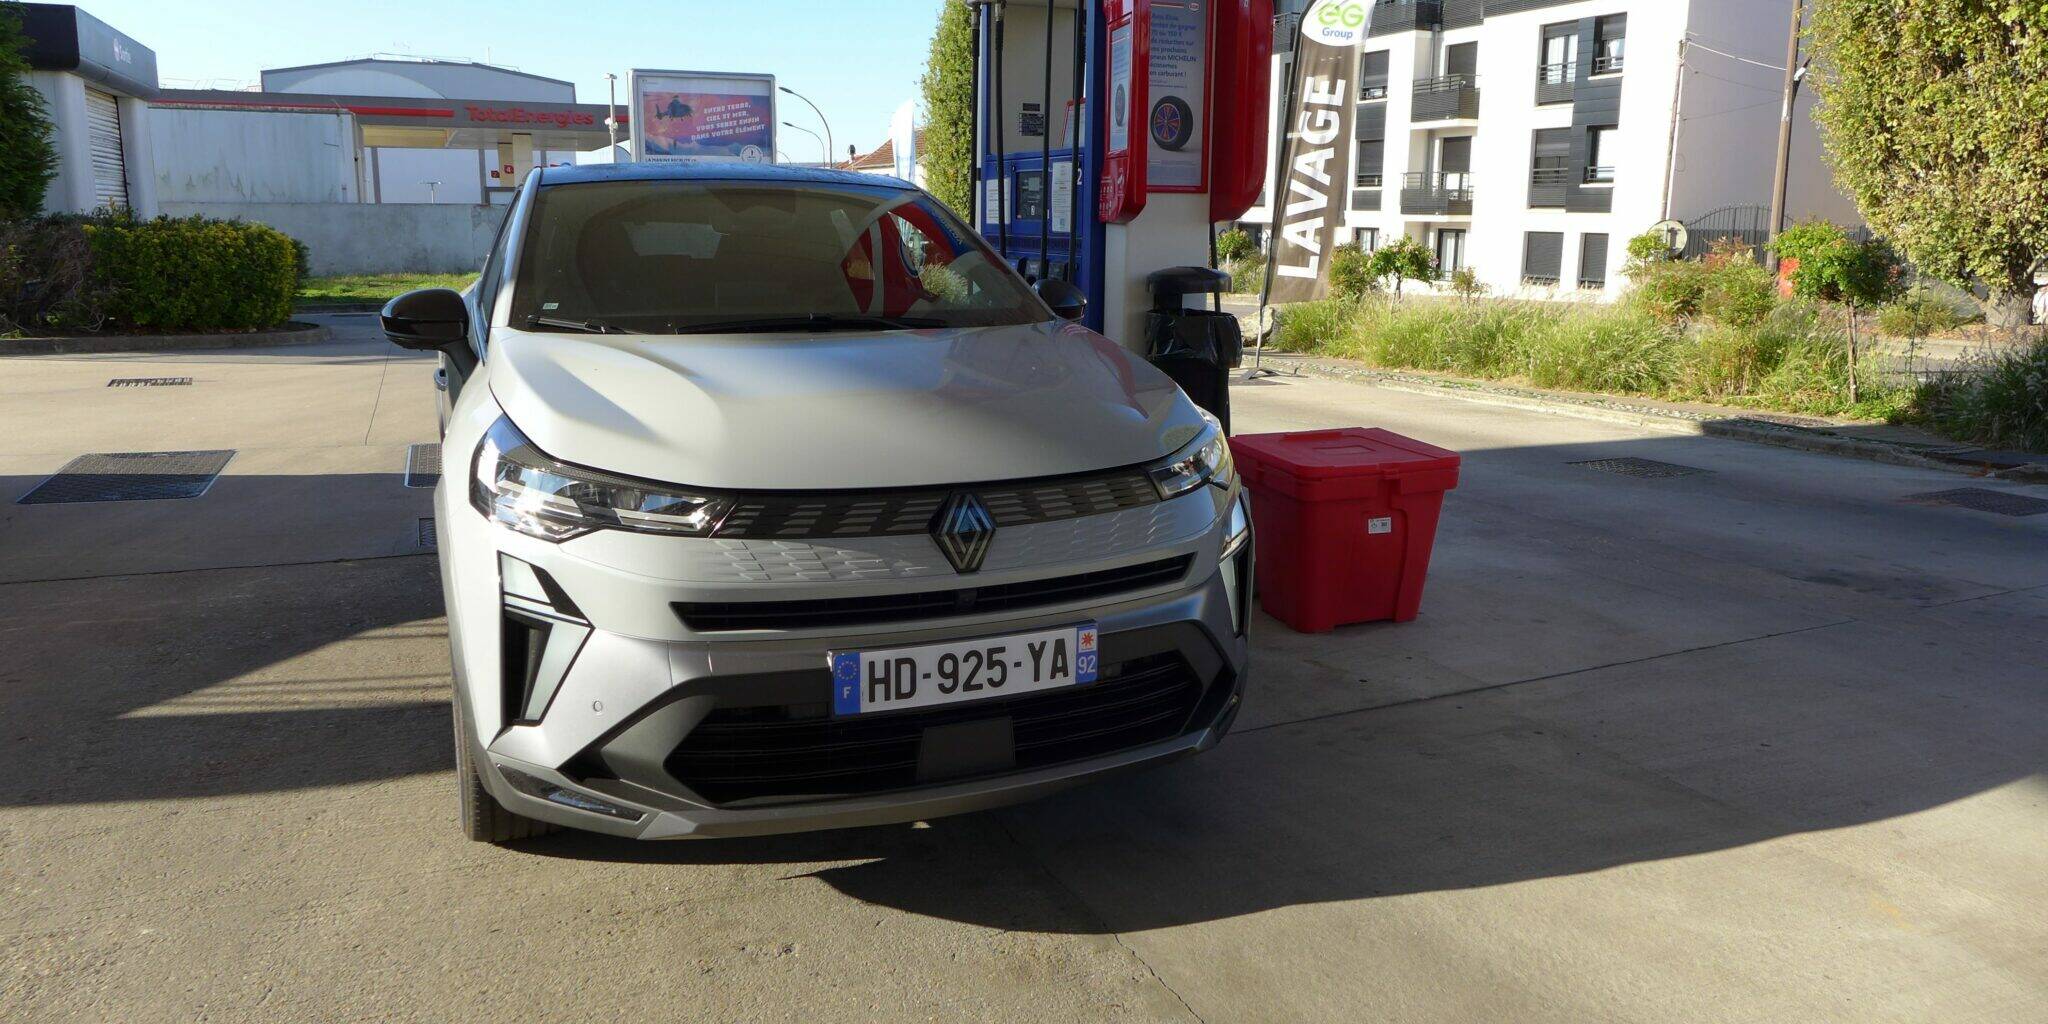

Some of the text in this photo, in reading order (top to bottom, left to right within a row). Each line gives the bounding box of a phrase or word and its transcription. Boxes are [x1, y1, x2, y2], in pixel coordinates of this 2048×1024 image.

[1322, 26, 1354, 40] Group
[464, 103, 594, 129] TotalEnergies
[703, 102, 751, 114] ENTRE TERRE,
[696, 116, 760, 132] VOUS SEREZ ENFIN
[706, 114, 721, 122] CIEL
[691, 123, 765, 141] DANS VOTRE ÉLÉMENT
[1076, 167, 1083, 186] 2
[1277, 76, 1346, 279] LAVAGE
[868, 638, 1069, 703] HD-925-YA
[1078, 655, 1096, 674] 92
[843, 686, 851, 699] F
